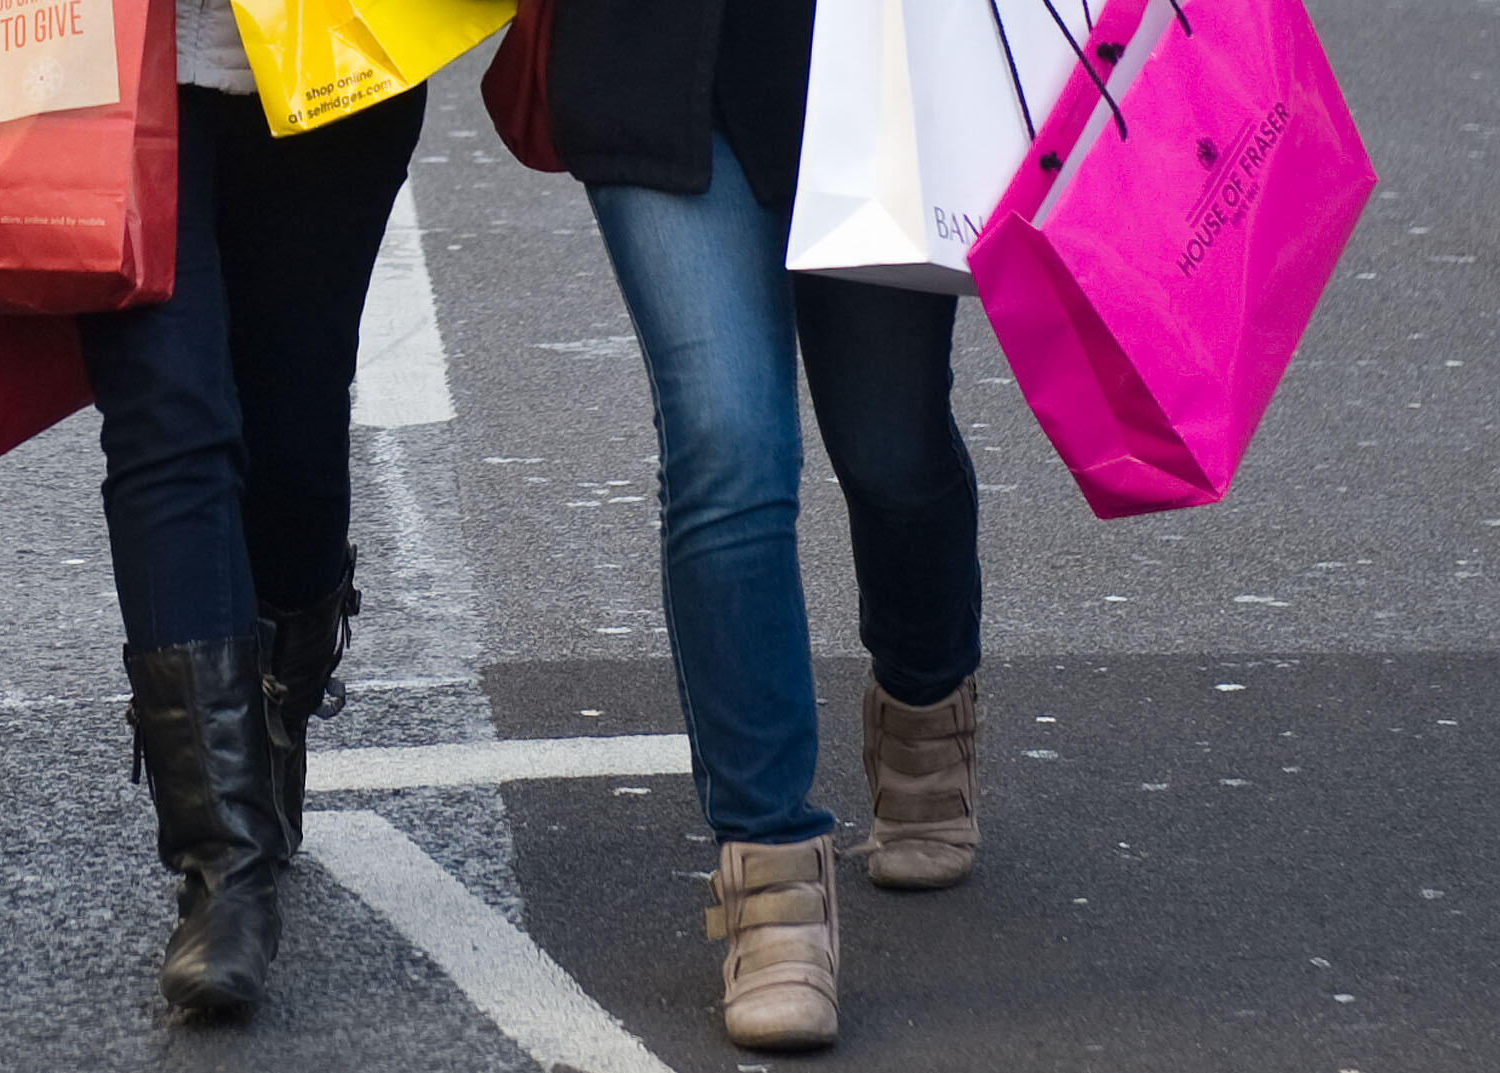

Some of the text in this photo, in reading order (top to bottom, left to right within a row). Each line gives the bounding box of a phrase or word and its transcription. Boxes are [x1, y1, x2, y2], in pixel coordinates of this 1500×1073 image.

[0, 0, 84, 51] TO GIVE
[288, 79, 392, 124] at selfridges.com
[306, 69, 373, 101] shop online
[1177, 202, 1228, 277] HOUSE
[1222, 171, 1244, 207] OF
[1239, 102, 1290, 177] FRASER
